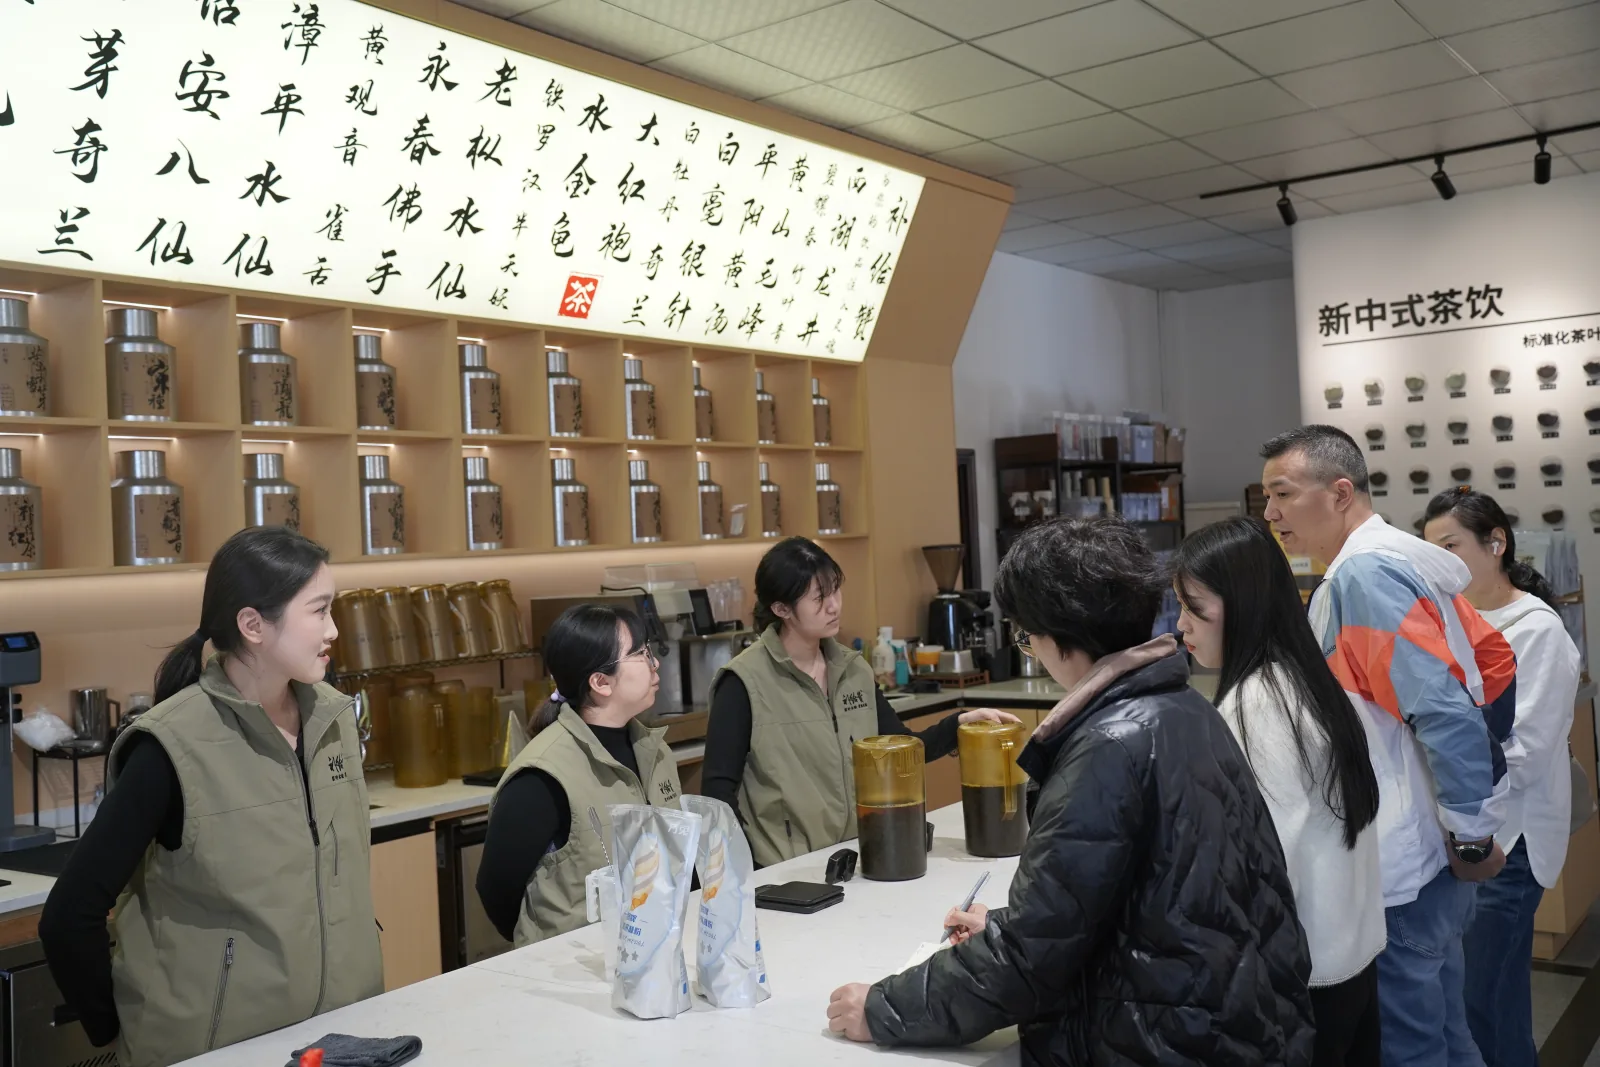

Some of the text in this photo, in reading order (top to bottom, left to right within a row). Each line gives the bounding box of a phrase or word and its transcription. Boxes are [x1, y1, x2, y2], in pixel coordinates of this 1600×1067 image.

[38, 29, 125, 261] 芽奇兰
[223, 3, 325, 277] 漳平水仙
[366, 40, 460, 295] 永春佛手
[598, 111, 660, 263] 大红袍
[664, 131, 740, 331] 白毫银针
[738, 153, 809, 339] 黄山毛峰
[798, 167, 867, 346] 西湖龙井
[1318, 283, 1505, 338] 新中式茶饮
